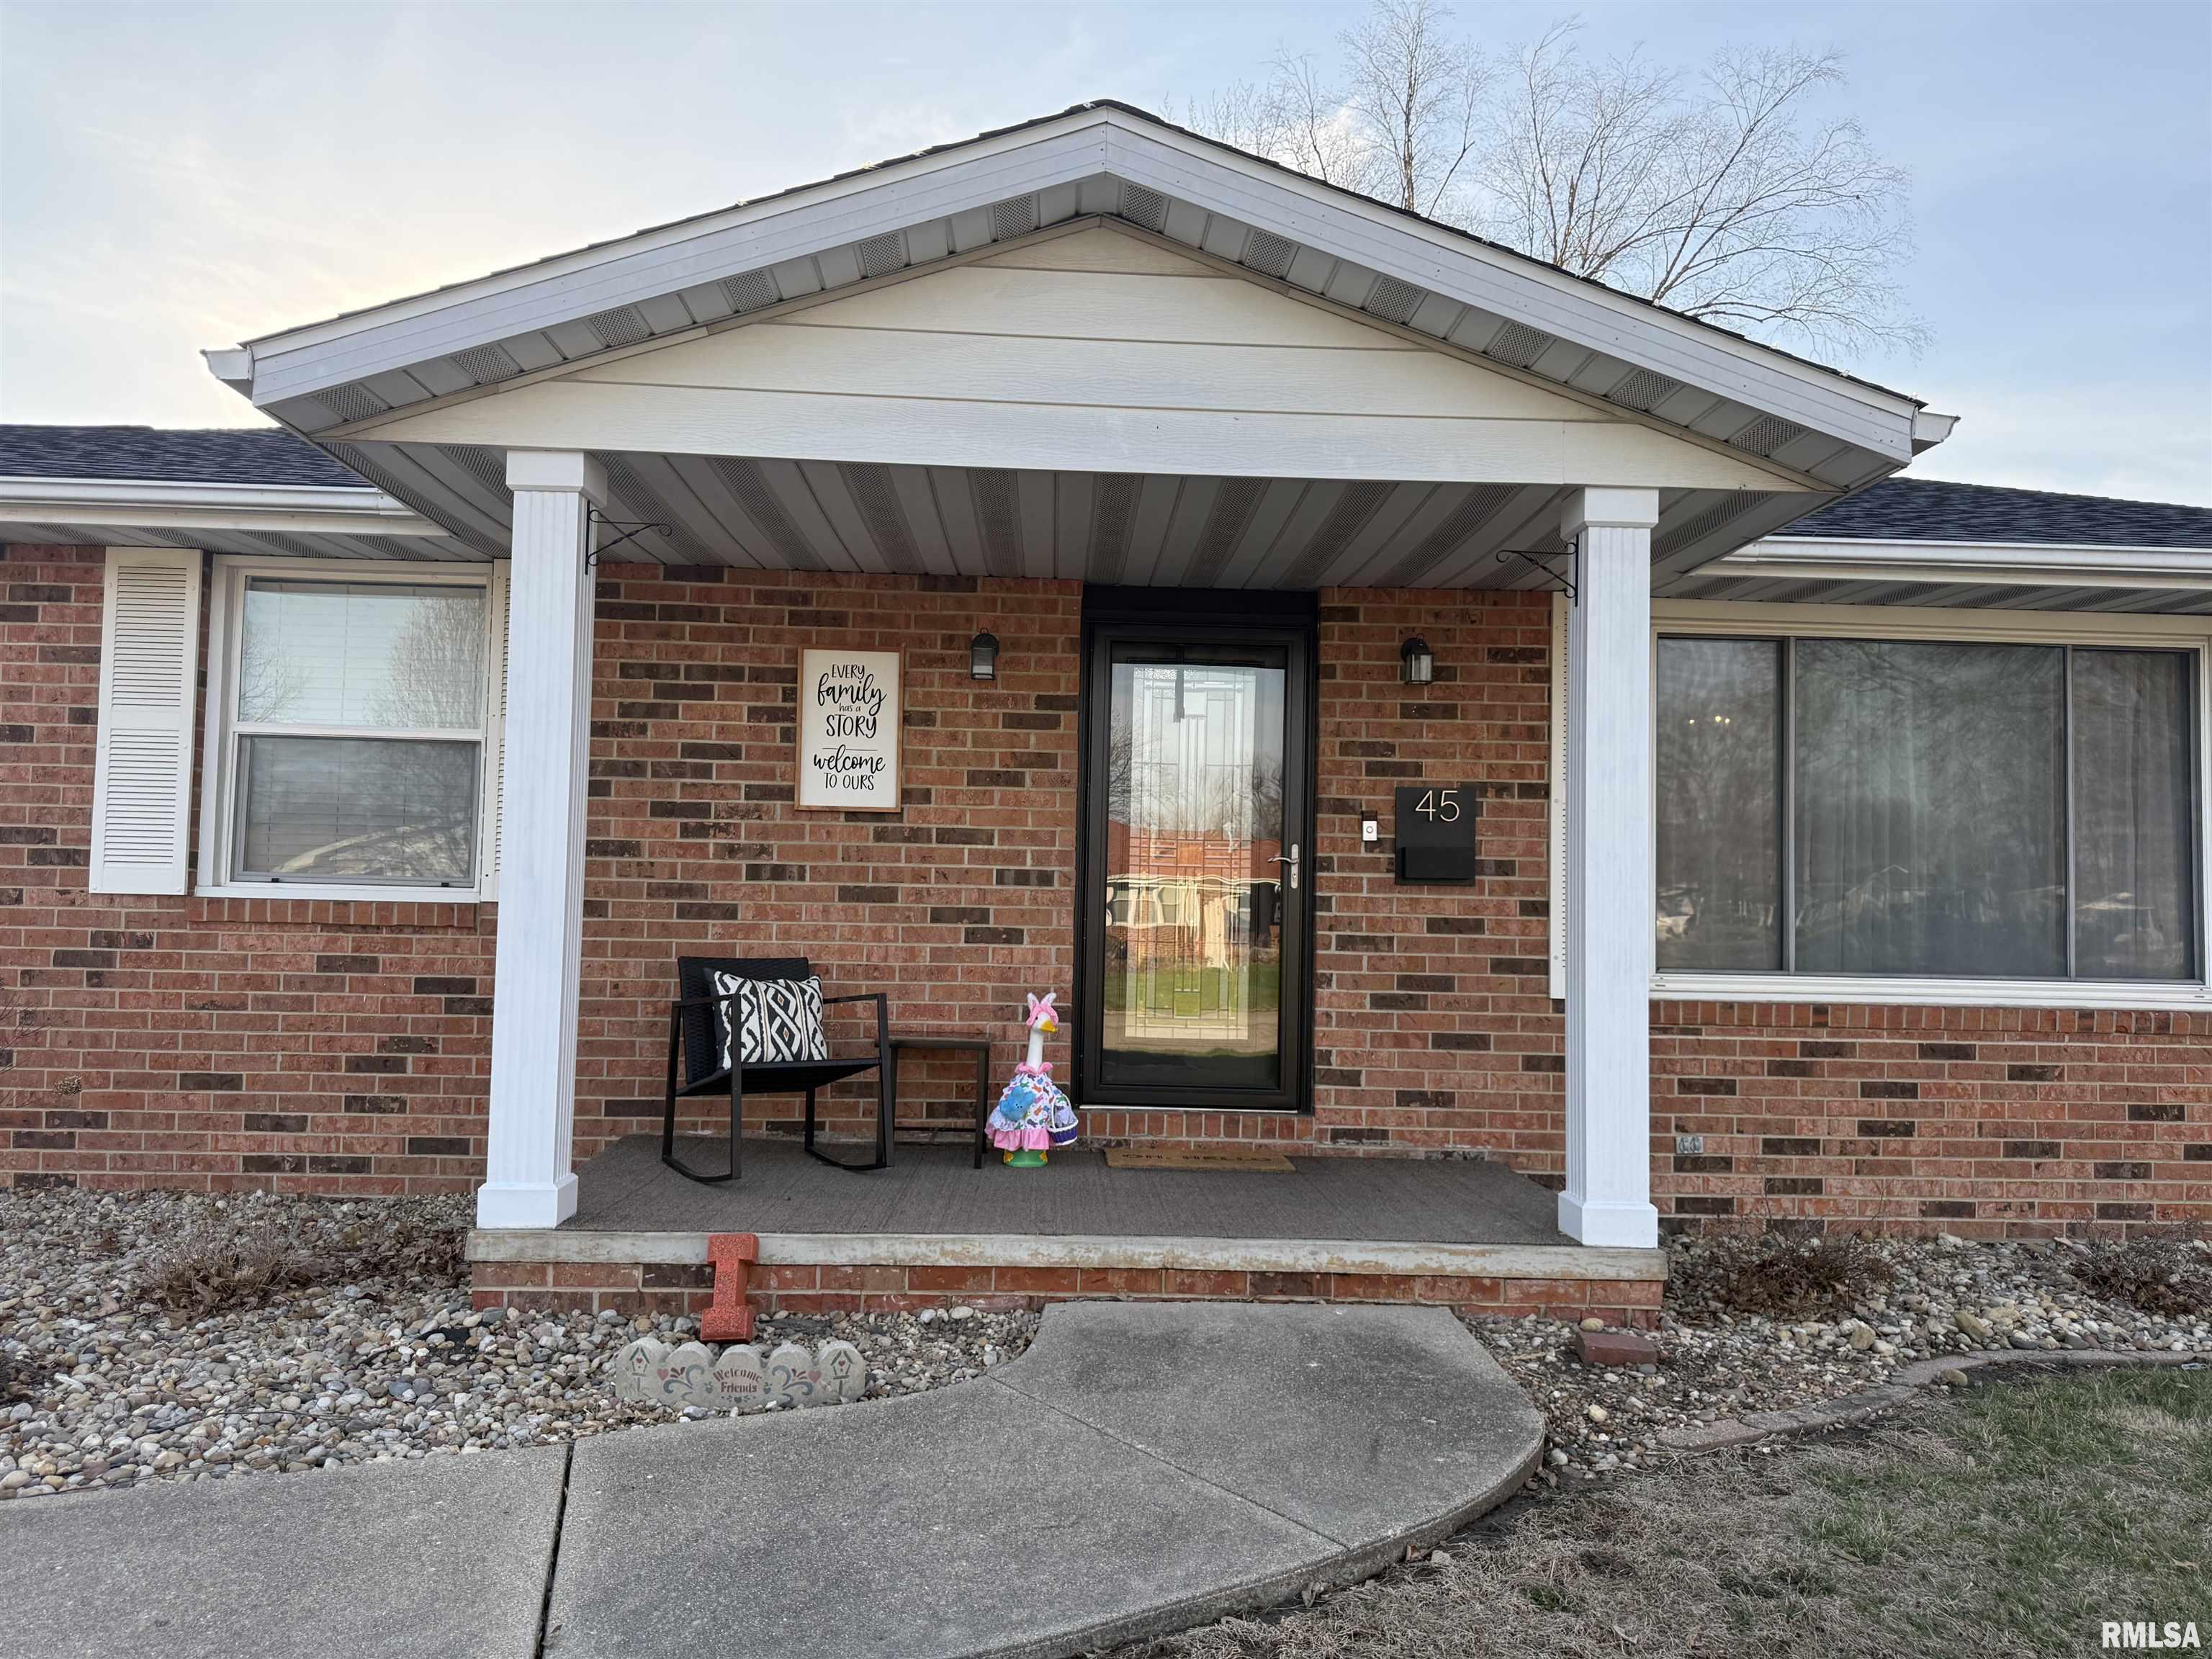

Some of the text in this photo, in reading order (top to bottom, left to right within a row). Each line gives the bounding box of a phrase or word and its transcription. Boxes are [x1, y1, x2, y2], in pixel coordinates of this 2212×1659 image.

[832, 664, 865, 680] EVERY
[817, 673, 887, 716] family
[839, 703, 853, 712] has
[826, 714, 877, 739] STORY
[813, 745, 886, 774] welcome
[823, 772, 875, 791] TO OURS
[1415, 790, 1460, 822] 45
[713, 1367, 763, 1383] Welcome
[721, 1382, 757, 1393] Friends
